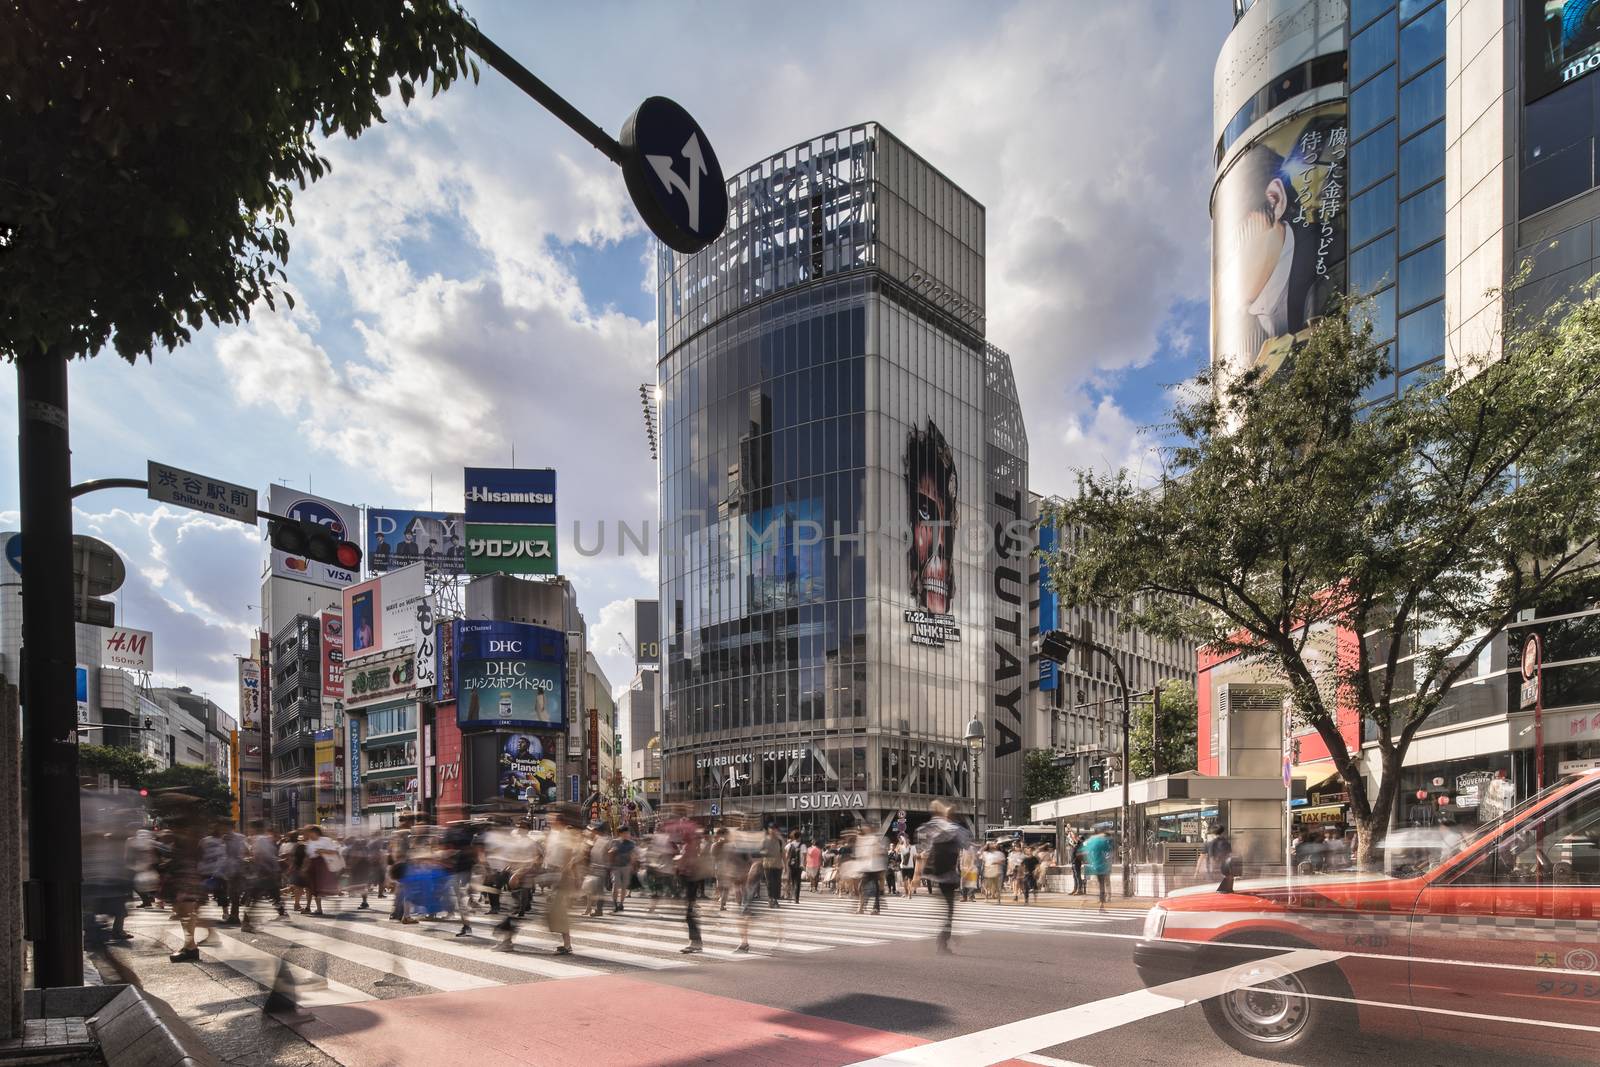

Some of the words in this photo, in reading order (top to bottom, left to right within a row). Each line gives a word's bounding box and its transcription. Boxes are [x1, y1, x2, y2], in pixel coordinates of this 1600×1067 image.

[158, 469, 249, 508] 渋谷駅前
[465, 486, 553, 504] Hisamitsu
[173, 491, 214, 511] Shibuya
[219, 504, 239, 515] Sta.
[468, 539, 551, 558] サロンパス
[327, 569, 353, 583] VISA
[995, 490, 1021, 758] TSUTAYA
[107, 632, 147, 656] H&M
[417, 598, 434, 684] もんじゃ
[489, 641, 522, 652] DHC
[486, 662, 526, 676] DHC
[464, 677, 553, 692] エルシスホワイト240
[511, 763, 545, 772] Planets
[697, 753, 755, 769] STARBUCKS
[762, 749, 806, 761] COFFEE
[910, 755, 968, 772] TSUTAYA
[790, 793, 864, 809] TSUTAYA
[1302, 813, 1319, 823] TAX
